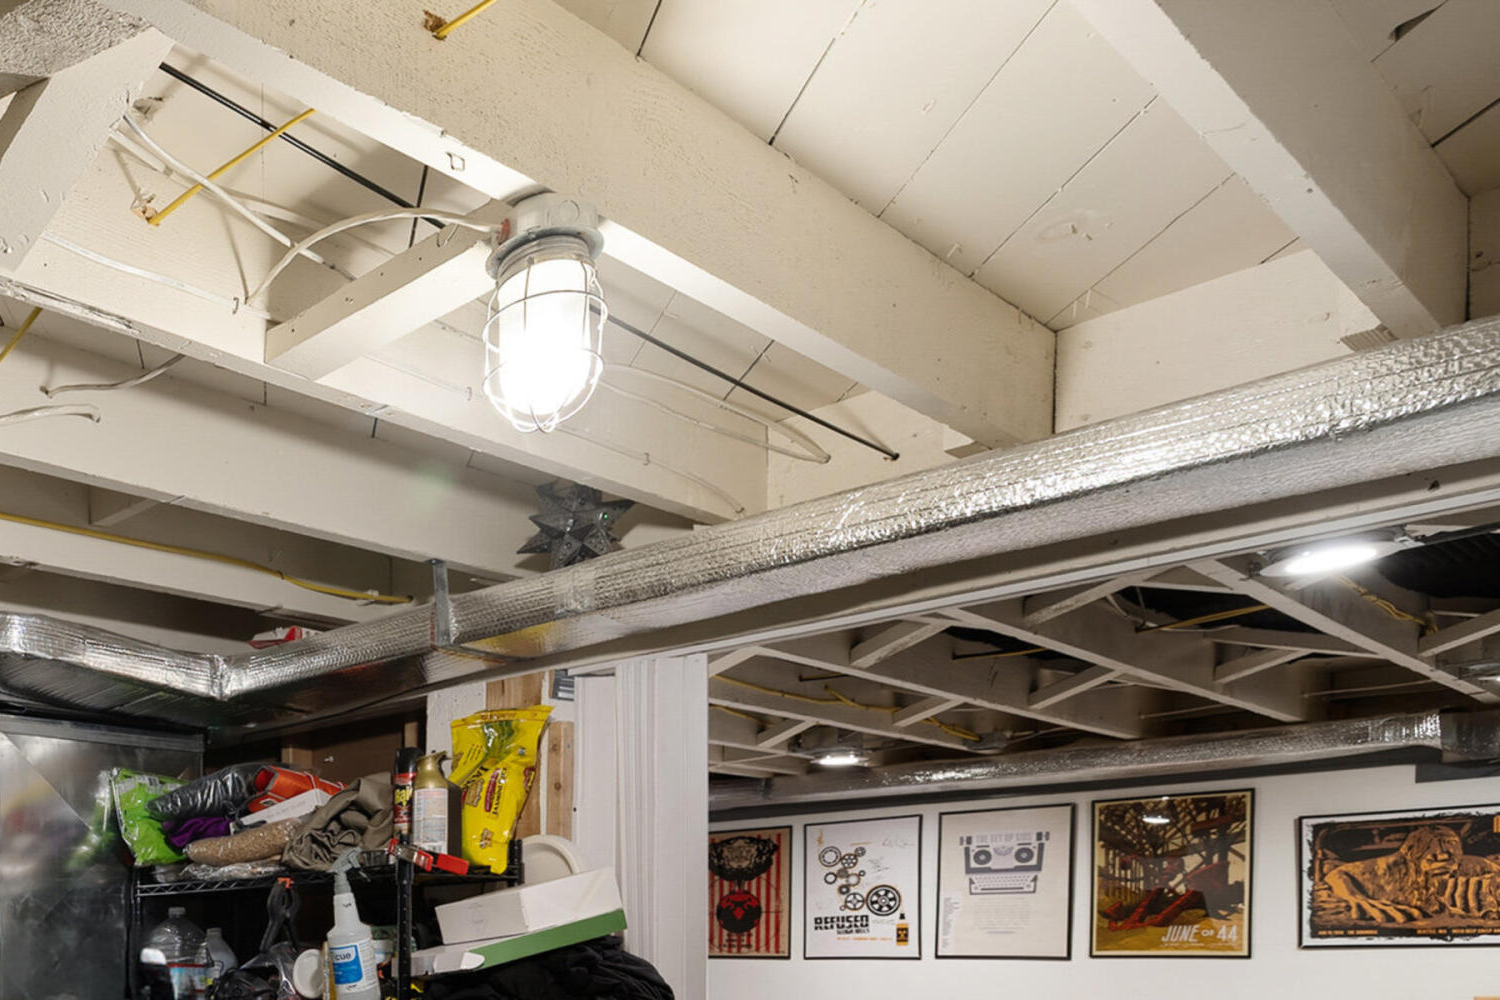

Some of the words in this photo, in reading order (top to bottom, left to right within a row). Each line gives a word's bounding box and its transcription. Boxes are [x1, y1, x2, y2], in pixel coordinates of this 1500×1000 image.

[813, 914, 869, 931] REFUSED
[1161, 924, 1200, 942] JUNE
[1216, 924, 1237, 942] 44
